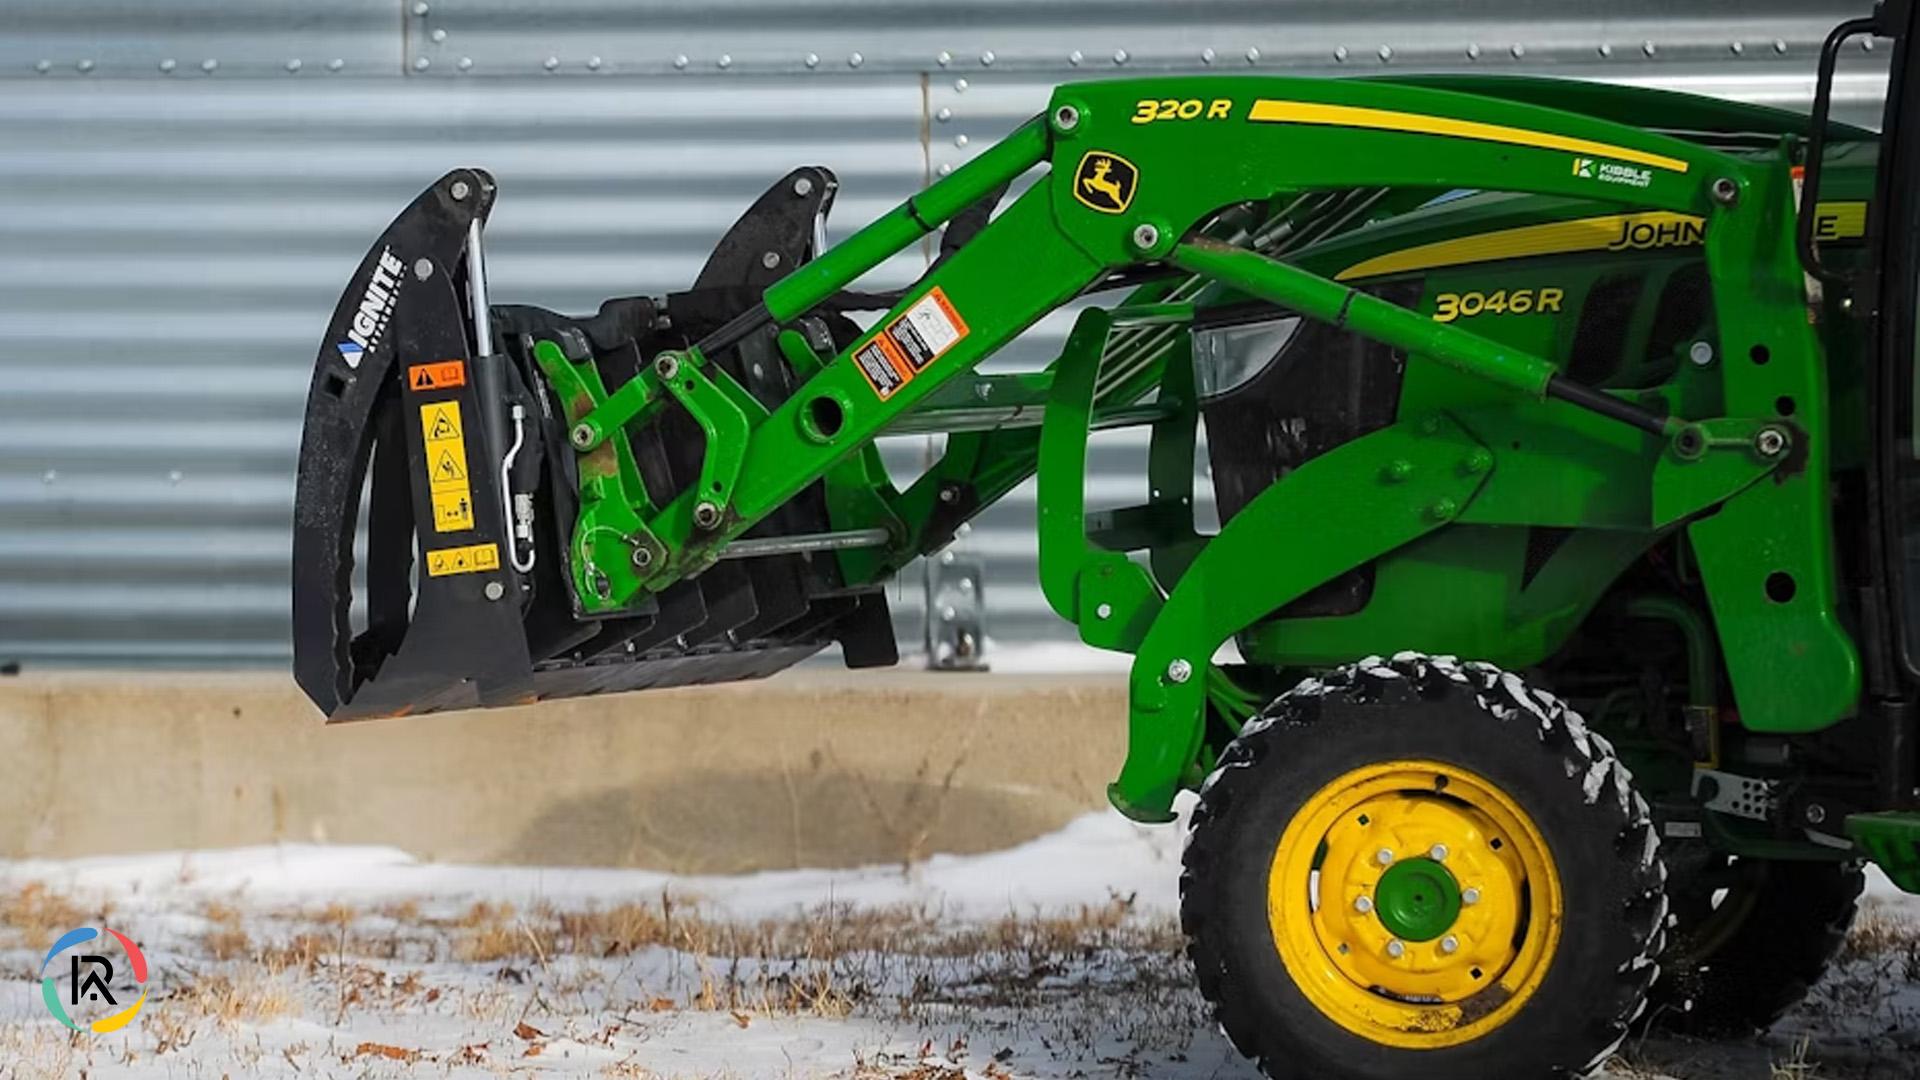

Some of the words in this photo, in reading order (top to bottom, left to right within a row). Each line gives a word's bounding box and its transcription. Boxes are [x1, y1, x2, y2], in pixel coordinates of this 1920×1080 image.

[1131, 99, 1204, 124] 320
[1206, 99, 1233, 119] R
[1599, 163, 1653, 180] KIBBLE
[1607, 220, 1707, 247] JOHN
[347, 250, 403, 349] IGNITE
[1432, 289, 1534, 323] 3046
[1536, 287, 1565, 313] R
